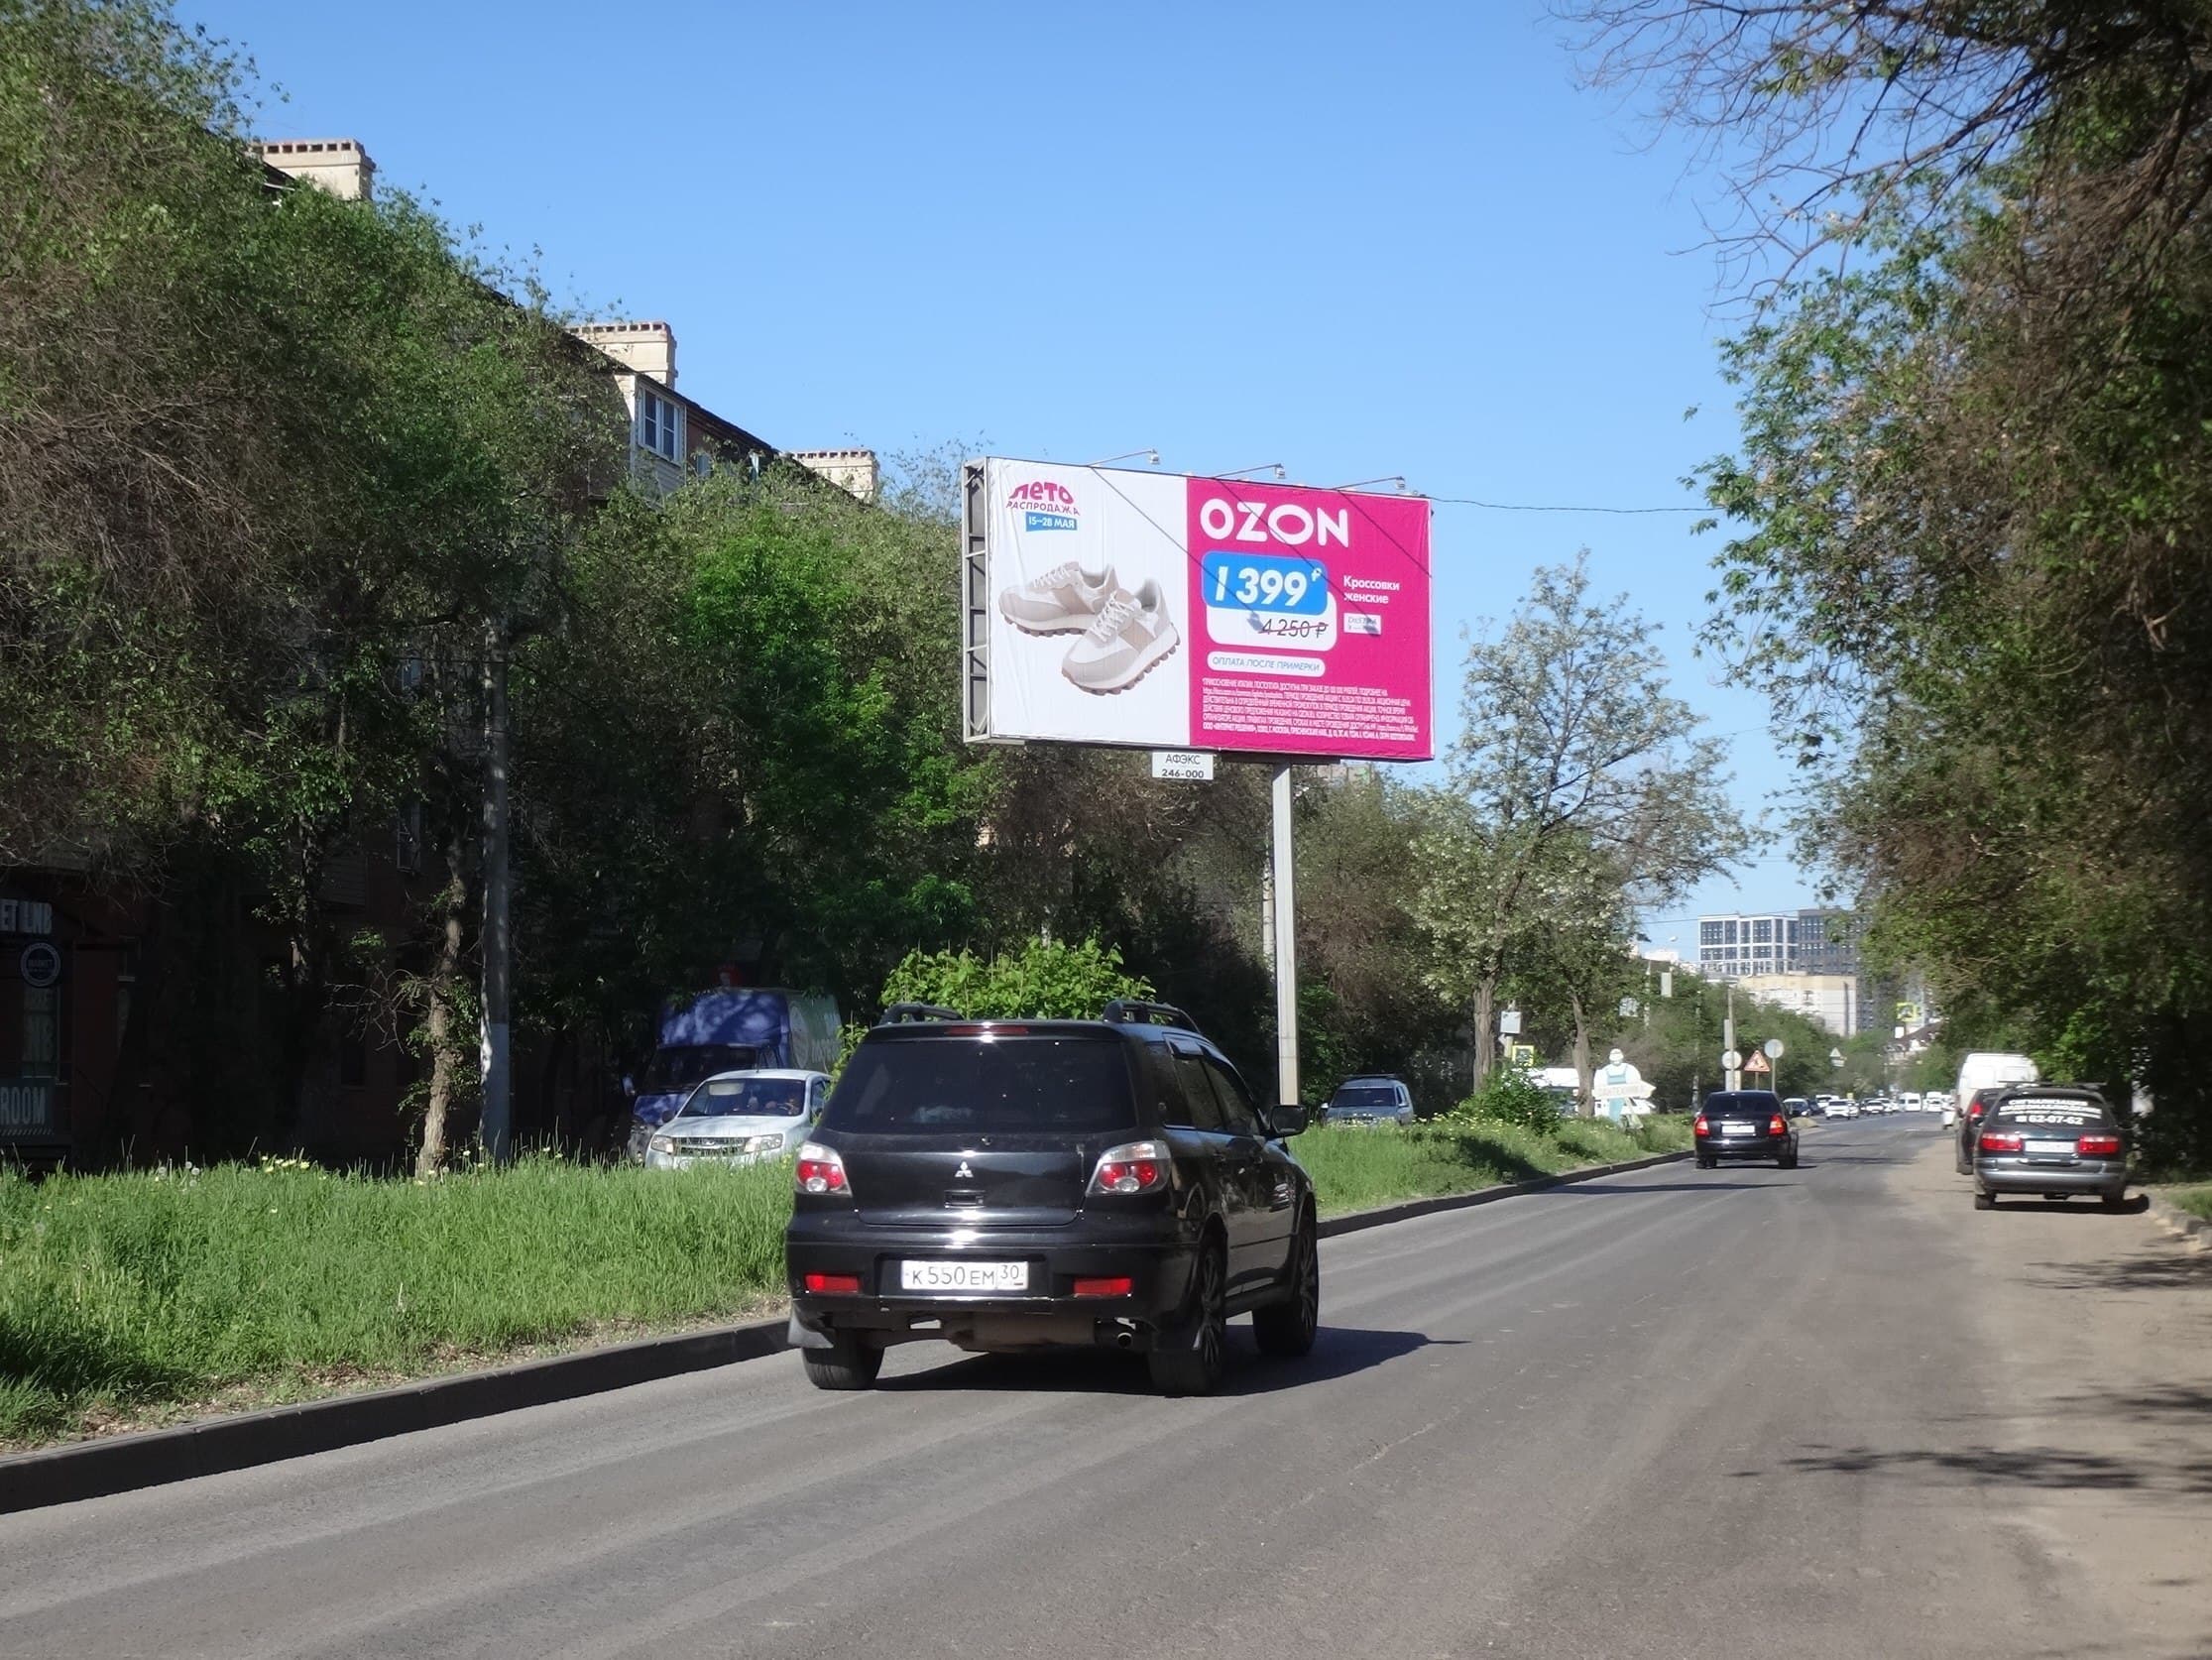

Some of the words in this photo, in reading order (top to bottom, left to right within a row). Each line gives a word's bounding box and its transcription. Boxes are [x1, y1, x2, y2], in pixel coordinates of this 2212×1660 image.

[1005, 500, 1081, 517] РАСПРОДАЖА
[1054, 520, 1075, 529] МАЯ
[1200, 498, 1349, 547] OZON
[1343, 575, 1400, 592] Кроссовки
[1343, 592, 1389, 605] женские
[1212, 655, 1246, 667] ОПЛАТА
[1246, 658, 1275, 669] ПОСЛЕ
[1277, 660, 1321, 672] ПРИМЕРКИ
[1165, 754, 1201, 766] АФЭКС
[1161, 769, 1205, 778] 246-000
